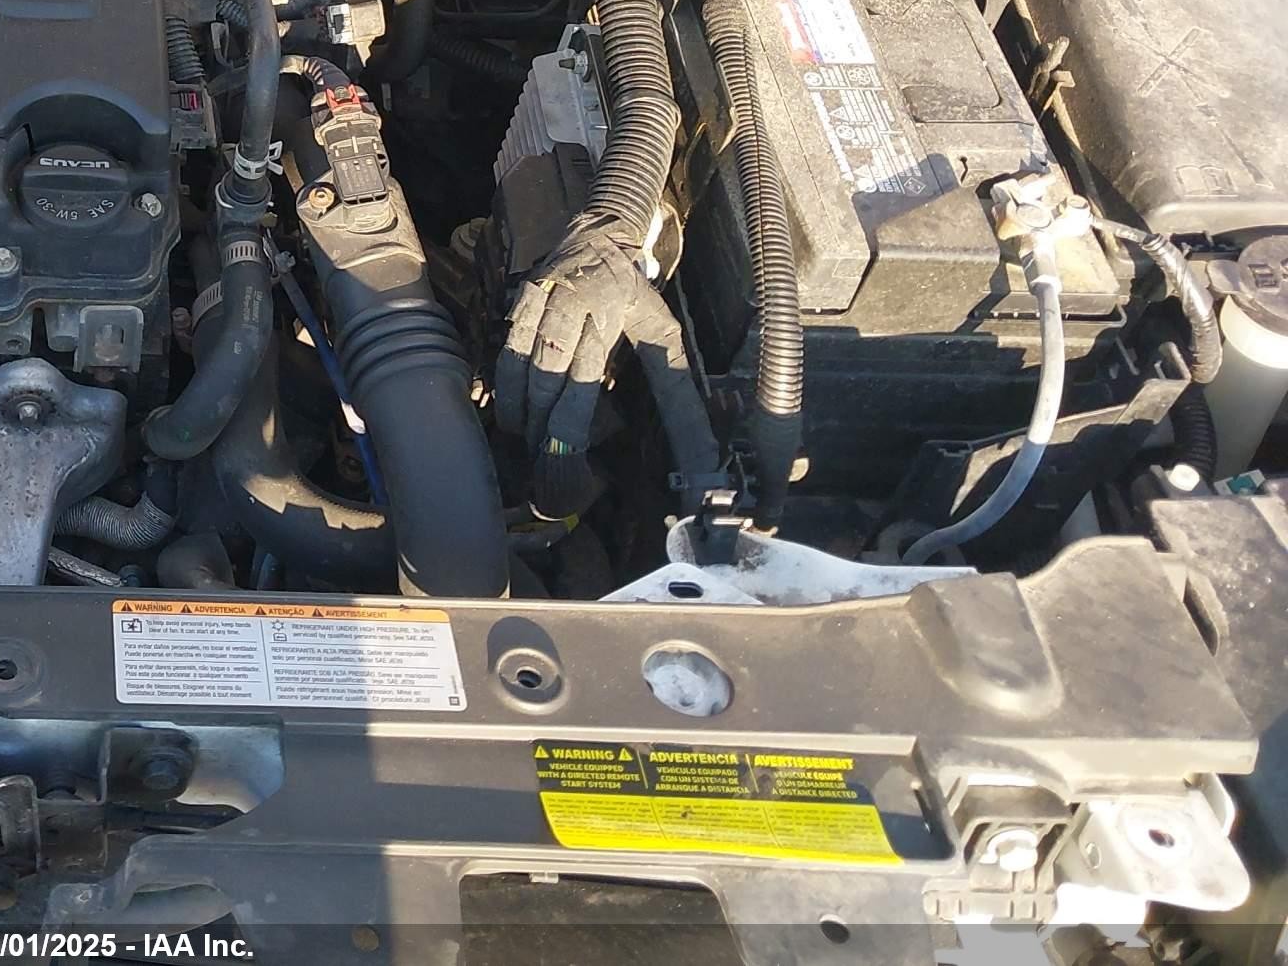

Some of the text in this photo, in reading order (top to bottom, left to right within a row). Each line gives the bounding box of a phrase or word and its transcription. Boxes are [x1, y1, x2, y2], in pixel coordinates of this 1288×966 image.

[36, 198, 114, 220] SAE 5W-30
[194, 606, 247, 614] ADVERTENCIA
[551, 748, 614, 760] WARNING
[649, 751, 739, 764] ADVERTENCIA
[754, 754, 853, 770] AVERTISSEMENT
[549, 763, 624, 772] VEHICLE EQUIPPED
[568, 772, 606, 780] DIRECTED
[607, 773, 640, 781] REMOTE
[697, 768, 737, 777] EQUIPADO
[588, 781, 621, 789] SYSTEM
[692, 776, 727, 784] SISTEMA
[728, 777, 739, 785] DE
[656, 784, 700, 792] ARRANQUE
[707, 786, 750, 794] DISTANCIA
[778, 788, 817, 796] DISTANCE
[819, 790, 857, 798] DIRECTED
